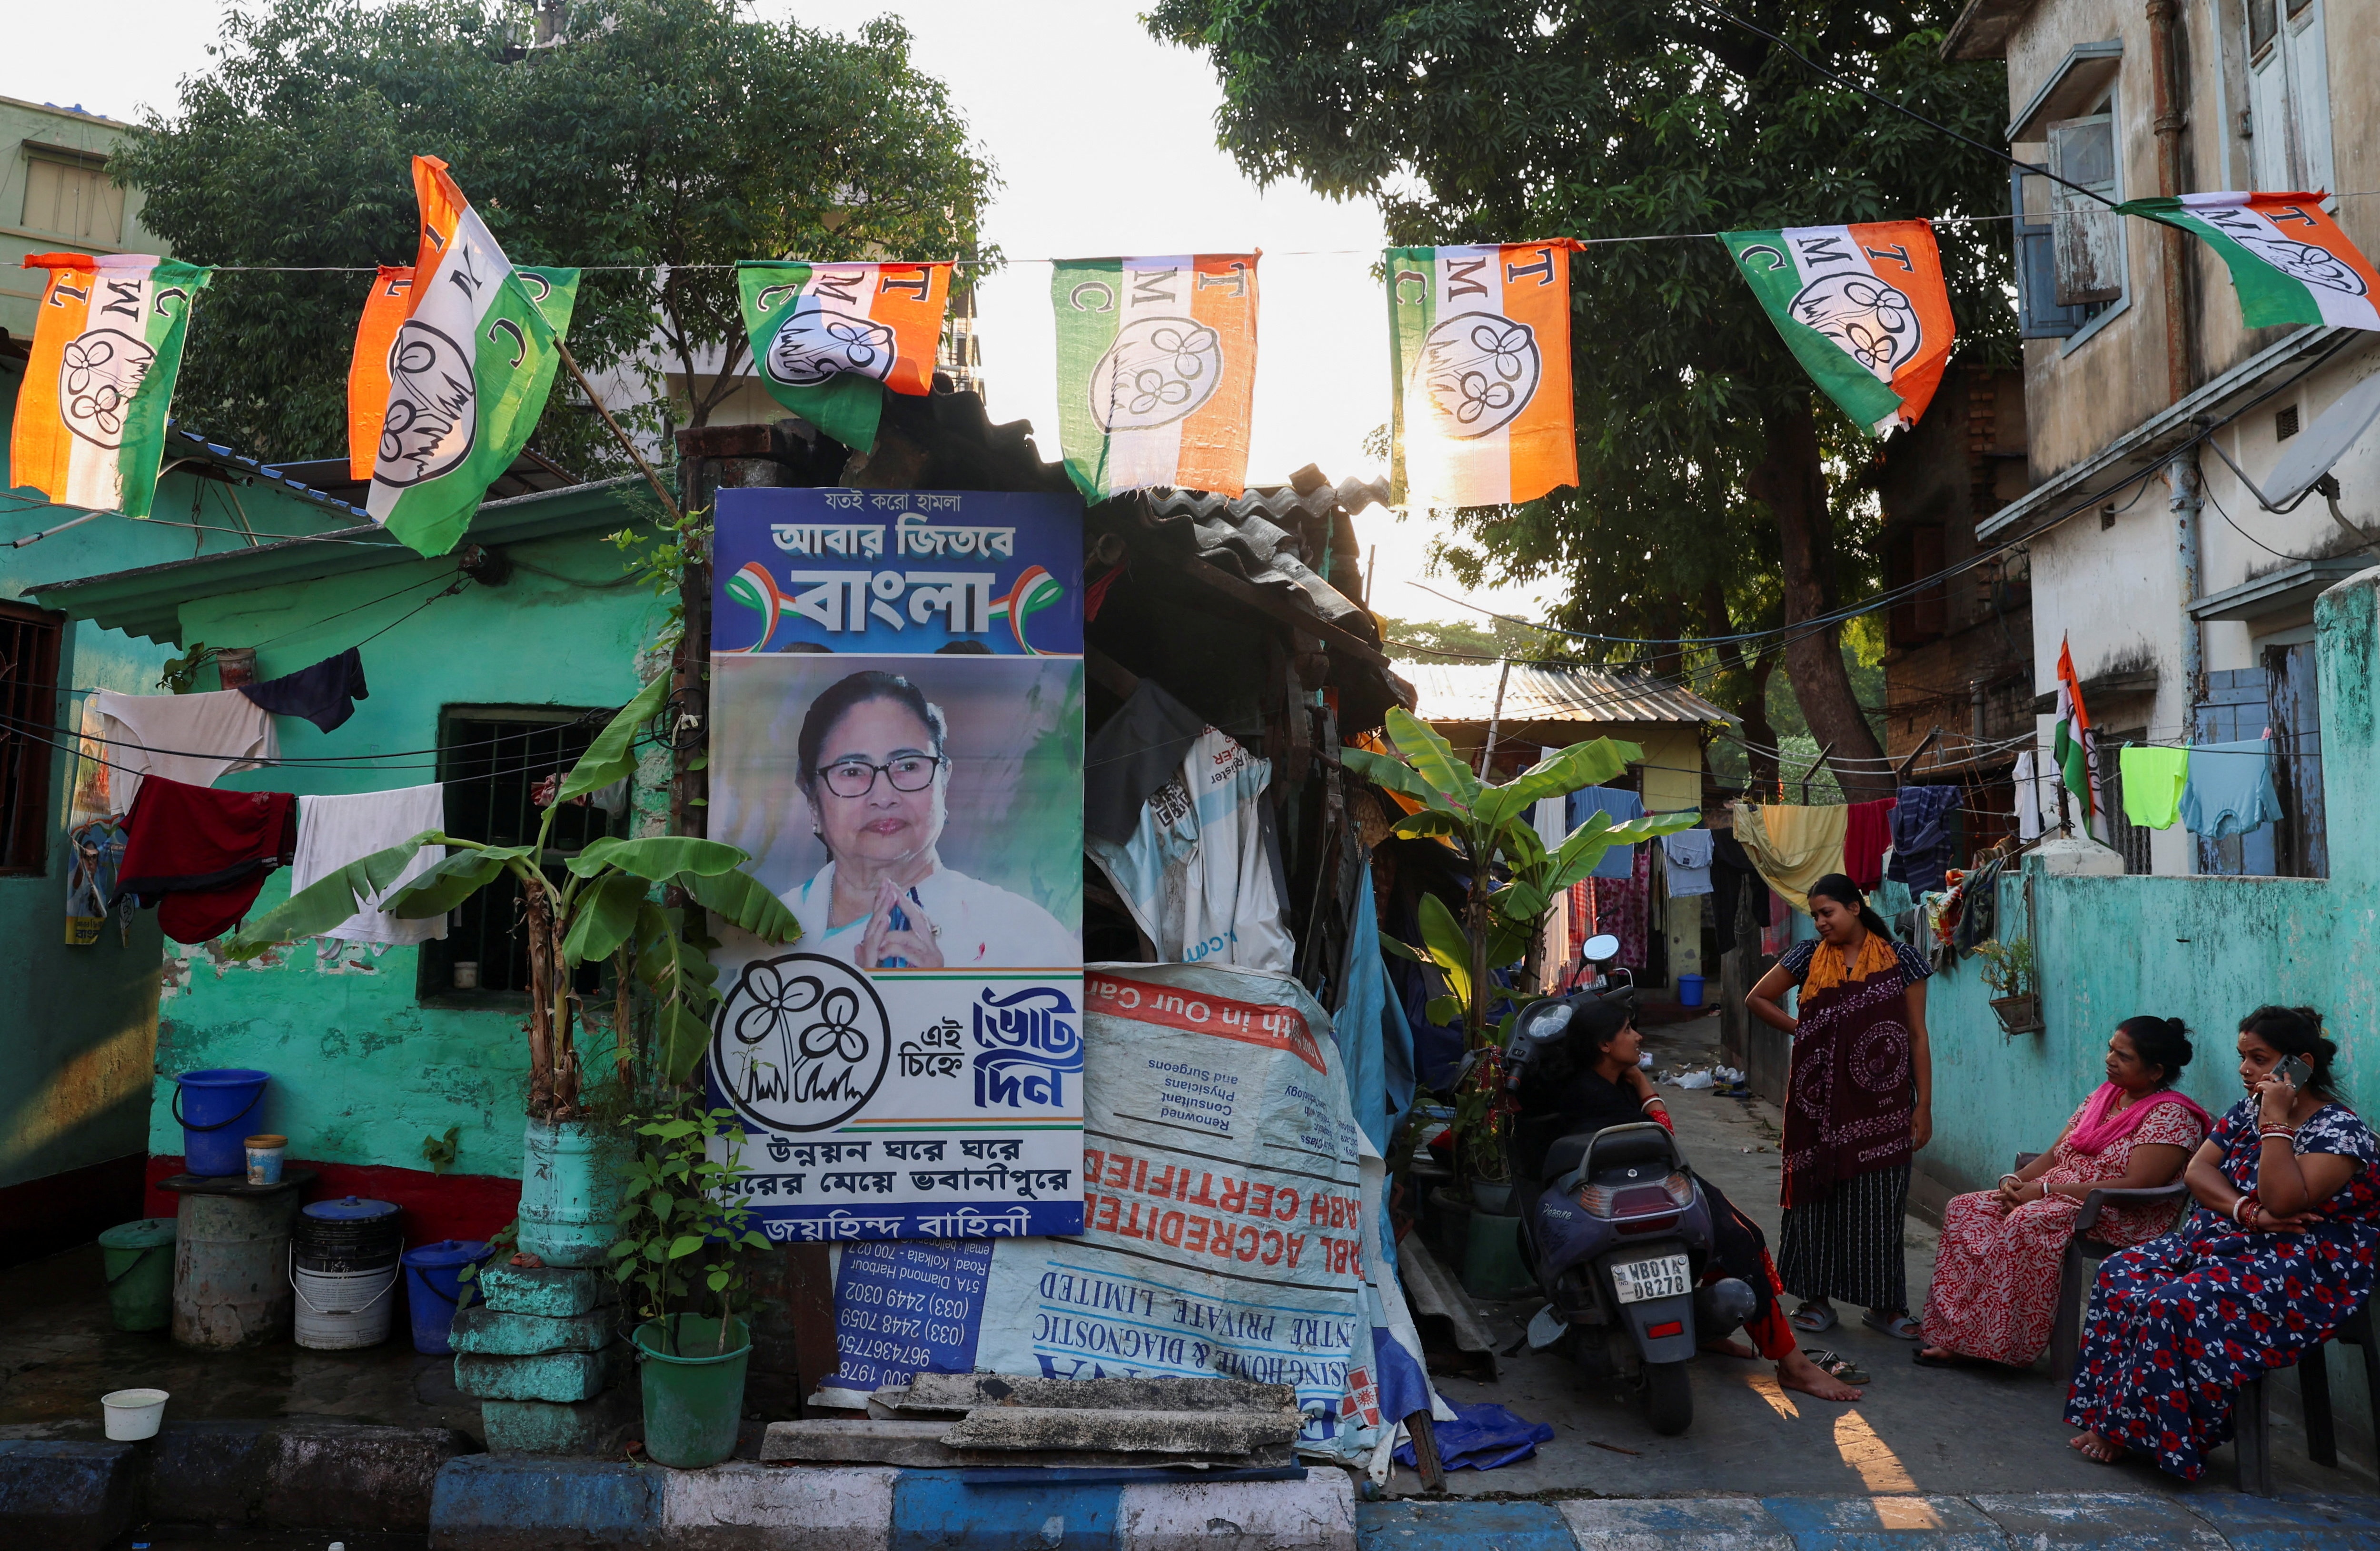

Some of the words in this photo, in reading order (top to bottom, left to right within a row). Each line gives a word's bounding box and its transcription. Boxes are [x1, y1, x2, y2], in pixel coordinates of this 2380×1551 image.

[825, 489, 863, 511] যতই
[871, 491, 908, 511] করো
[917, 492, 962, 512] হামলা
[771, 524, 886, 560] আবার
[895, 513, 1016, 557] জিতবে
[791, 570, 995, 632] বাংলা
[1084, 980, 1140, 1009] Car
[1150, 993, 1210, 1024] Our
[1222, 1007, 1250, 1032] in
[921, 1016, 963, 1050] এই
[973, 987, 1083, 1072] ভোট
[898, 1041, 965, 1078] চিহ্নে
[1303, 1035, 1323, 1067] Your
[973, 1048, 1083, 1109] দিন
[1148, 1059, 1210, 1081] Surgeons
[1214, 1072, 1238, 1086] and
[1165, 1077, 1235, 1102] Physicians
[1161, 1092, 1232, 1116] Consultant
[1160, 1107, 1230, 1131] Renowned
[767, 1135, 872, 1167] উন্নয়ন
[883, 1140, 947, 1162] ঘরে
[960, 1139, 1023, 1162] ঘরে
[1301, 1135, 1323, 1149] Class
[820, 1171, 897, 1196] মেয়ে
[909, 1163, 1072, 1201] ভবানীপুরে
[1084, 1148, 1299, 1222] CERTIFIED
[763, 1210, 904, 1243] জয়হিন্দ
[917, 1206, 1031, 1238] বাহিনী
[1310, 1193, 1361, 1230] ABH
[1542, 1203, 1572, 1220] Pleasure
[848, 1241, 872, 1256] 027
[875, 1245, 895, 1260] 700
[907, 1250, 950, 1270] Kolkata
[964, 1243, 990, 1255] email
[1319, 1237, 1363, 1280] ABL
[850, 1258, 897, 1280] Harbour
[900, 1267, 951, 1290] Diamond
[953, 1256, 987, 1276] Road,
[845, 1281, 883, 1304] 0302
[953, 1275, 980, 1293] 51A,
[1040, 1272, 1154, 1317] LIMITED
[886, 1288, 925, 1312] 2449
[929, 1292, 969, 1320] (033)
[841, 1308, 877, 1330] 7059
[882, 1314, 922, 1338] 2448
[925, 1318, 965, 1346] (033)
[1173, 1299, 1276, 1342] PRIVATE
[1032, 1313, 1184, 1365] DIAGNOSTIC
[1290, 1319, 1356, 1348] NTRE
[837, 1334, 930, 1367] 9674367750
[1192, 1342, 1210, 1369] &
[883, 1370, 913, 1385] 300
[1216, 1350, 1285, 1384] HOME
